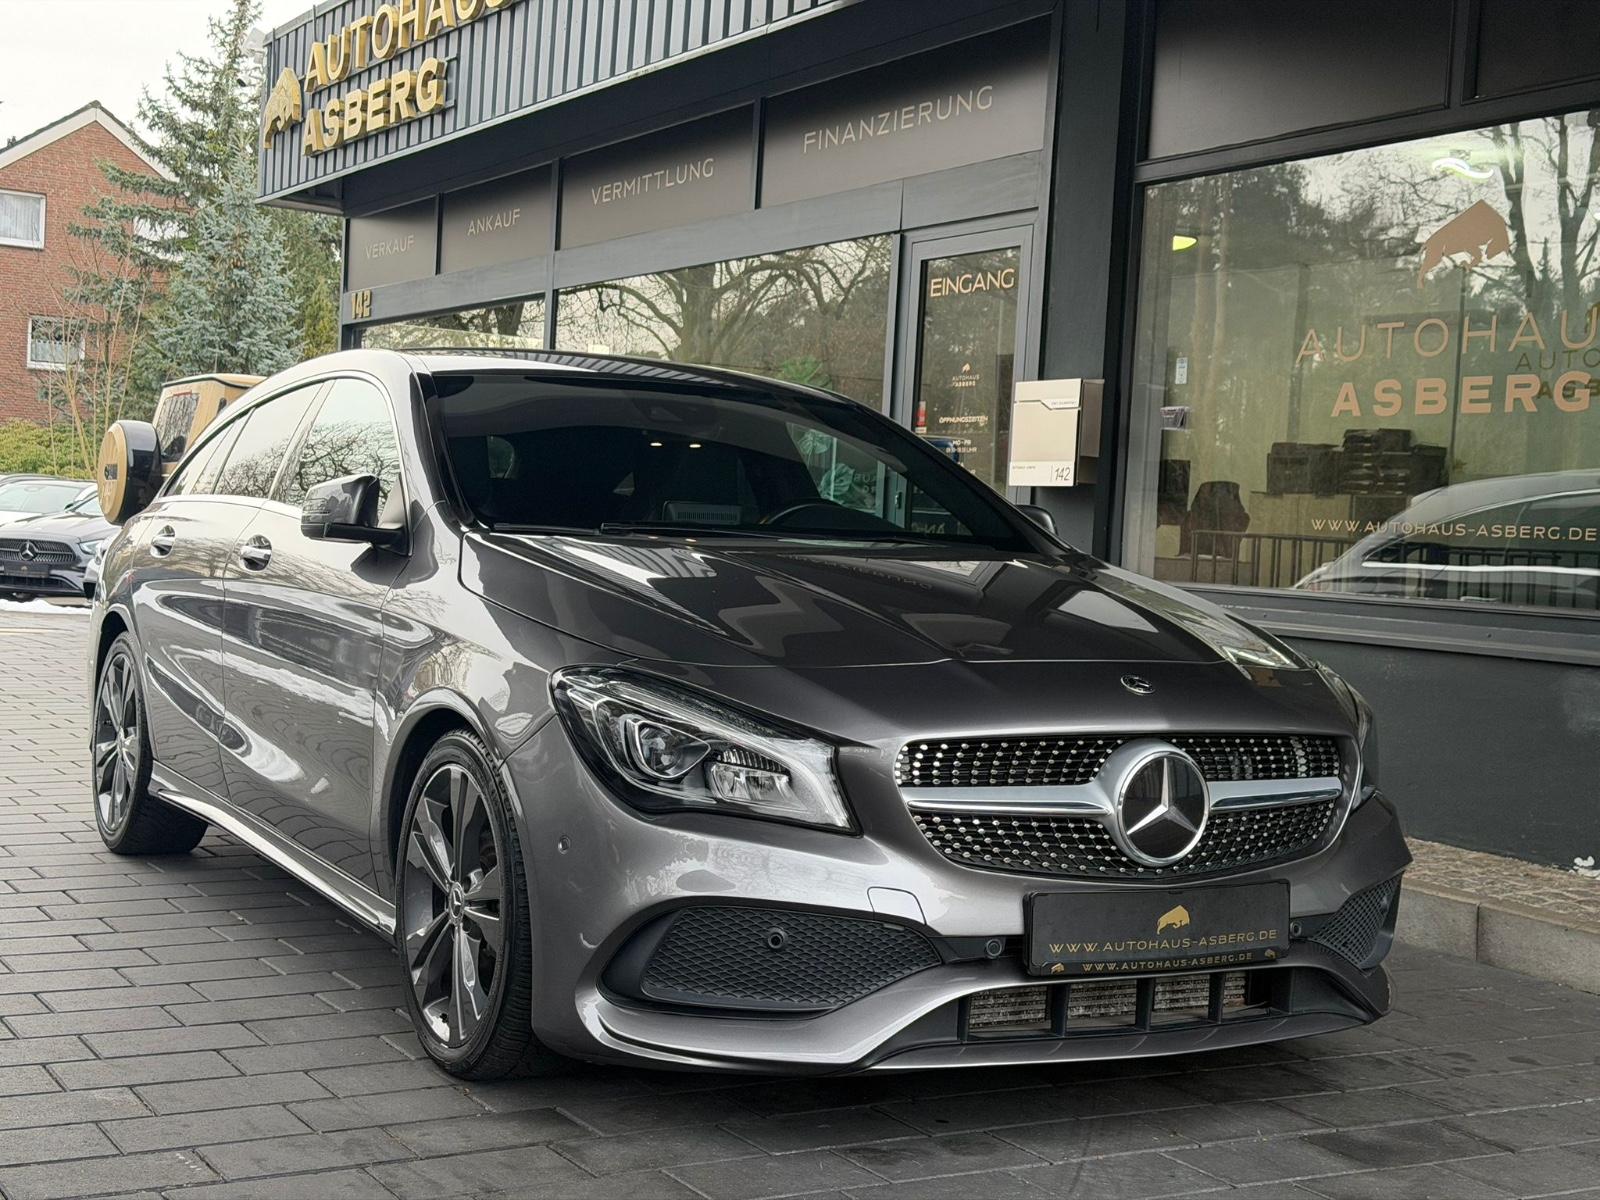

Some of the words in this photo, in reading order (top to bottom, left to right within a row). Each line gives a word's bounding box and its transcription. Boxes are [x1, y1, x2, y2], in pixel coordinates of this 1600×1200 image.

[303, 57, 447, 156] ASBERG
[803, 85, 994, 154] FINANZIERUNG
[591, 158, 715, 206] VERMITTLUNG
[467, 208, 521, 236] ANKAUF
[365, 235, 415, 259] VERKAUF
[930, 268, 1015, 298] EINGANG
[351, 289, 372, 319] 142
[1331, 370, 1592, 417] ASBERG
[1055, 467, 1071, 481] 142
[1311, 519, 1598, 541] WWW.AUTOHAUS-ASBERG.DE
[1049, 929, 1278, 954] WWW.AUTOHAUS-ASBERG.DE
[1082, 952, 1253, 972] WWW.AUTOHAUS-ASBERG.DE
